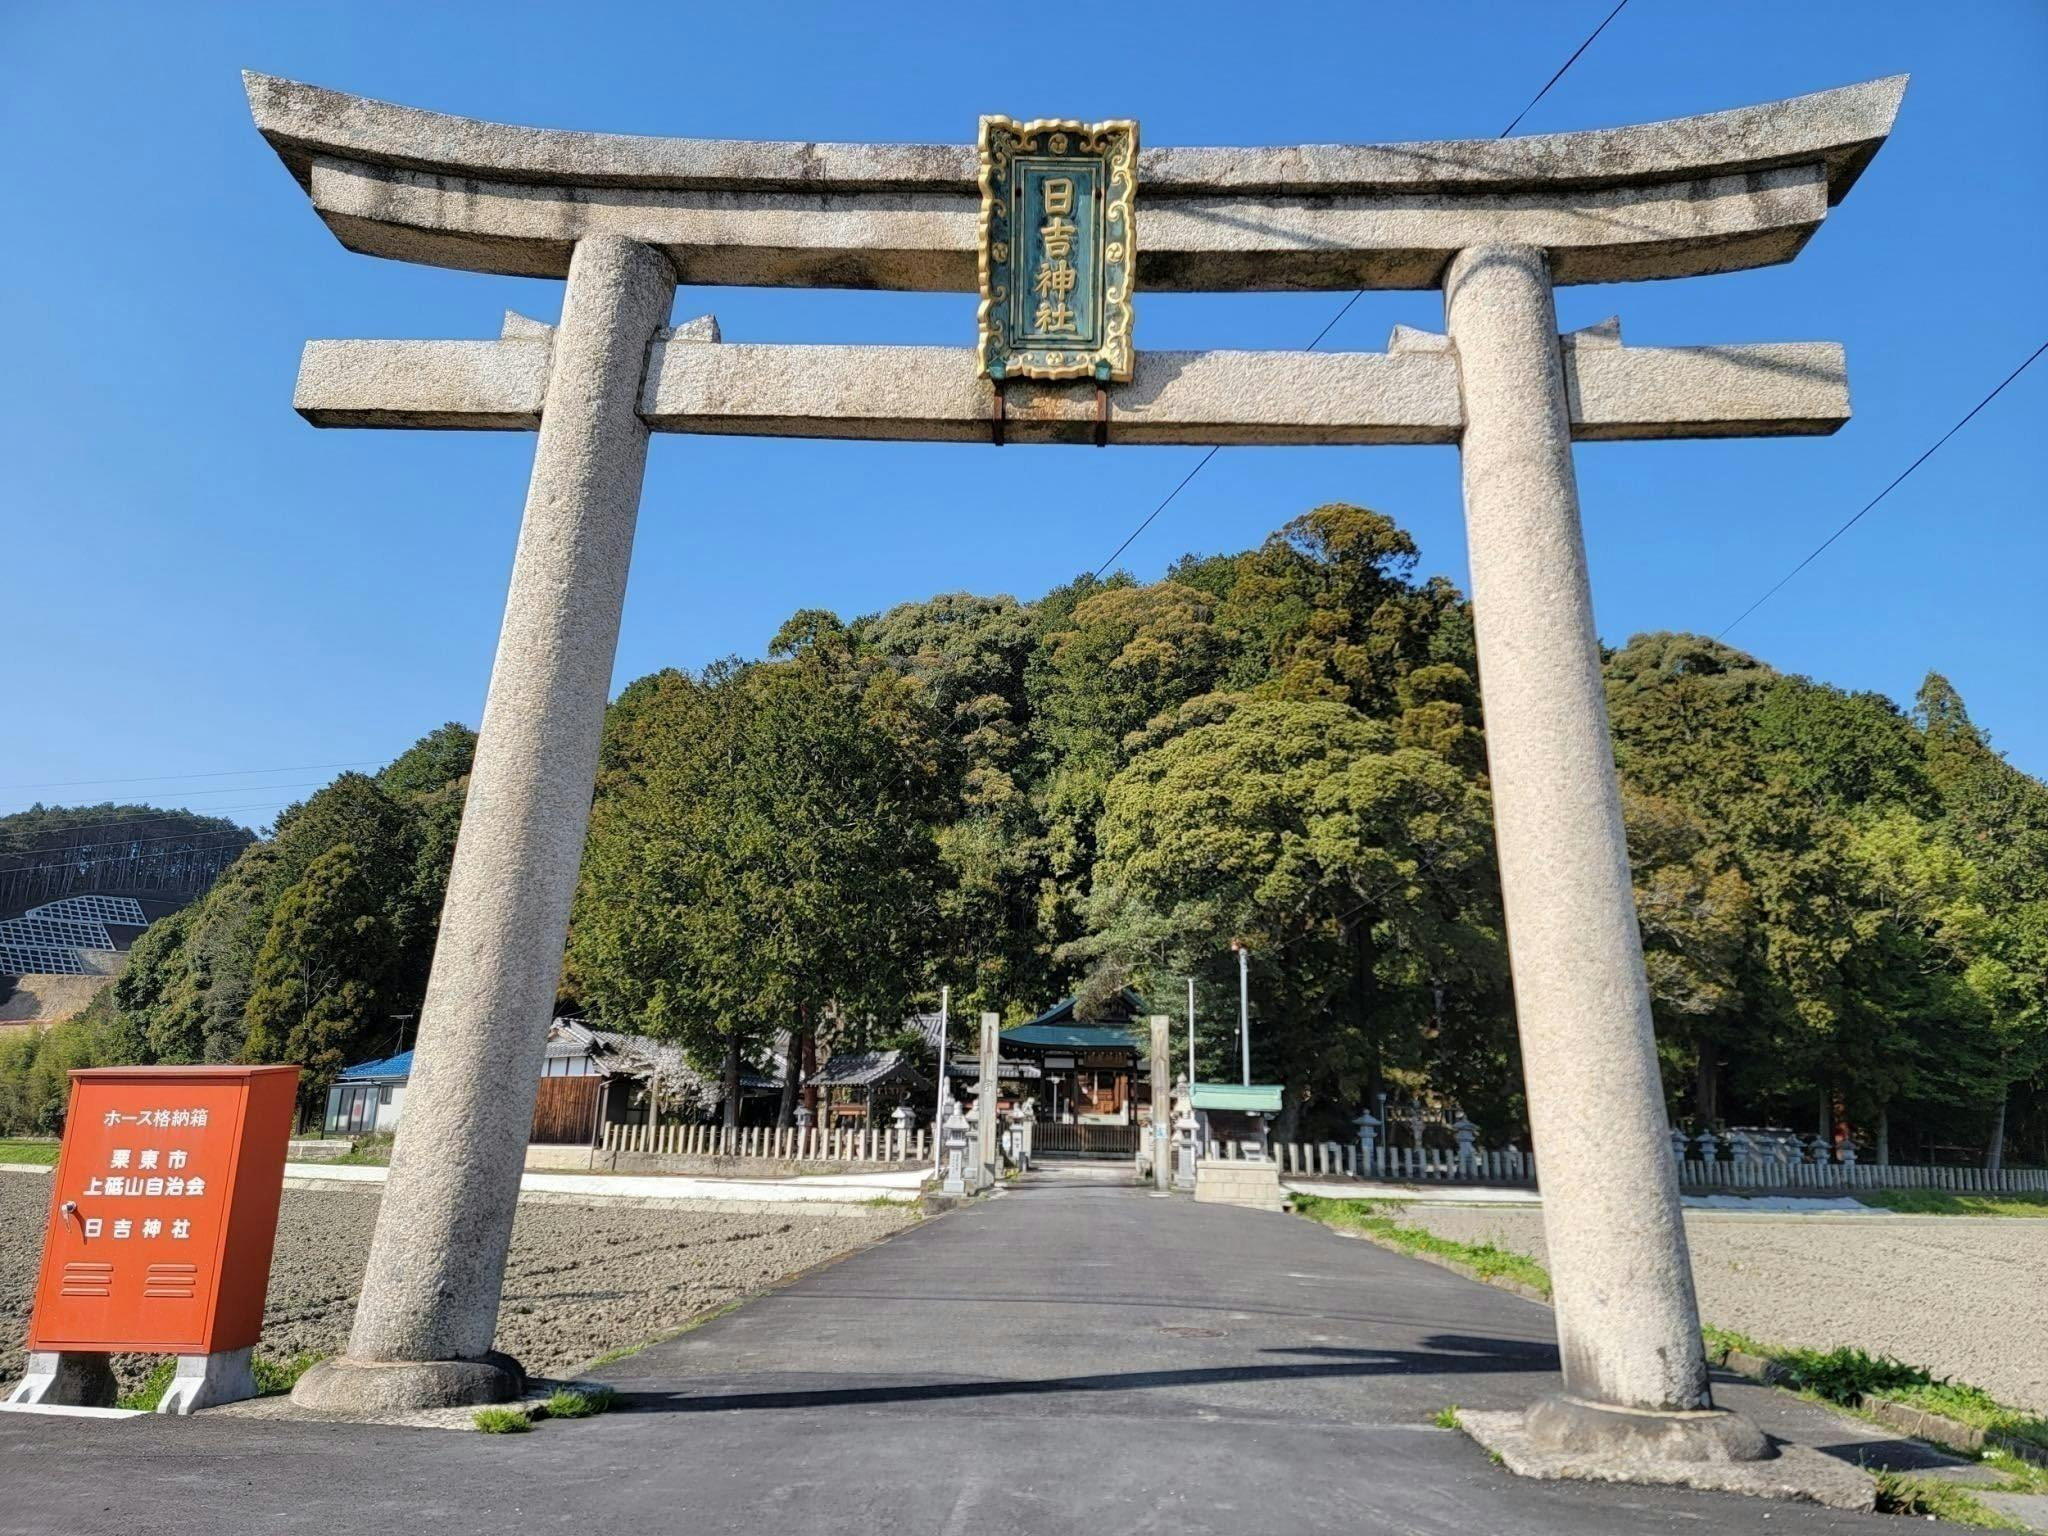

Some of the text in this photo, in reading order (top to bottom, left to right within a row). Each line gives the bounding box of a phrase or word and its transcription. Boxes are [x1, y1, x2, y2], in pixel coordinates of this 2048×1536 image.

[1034, 178, 1077, 332] 日吉神社
[103, 1109, 208, 1128] ホース格納箱
[110, 1149, 188, 1169] 栗東市
[85, 1218, 191, 1239] 日吉神社
